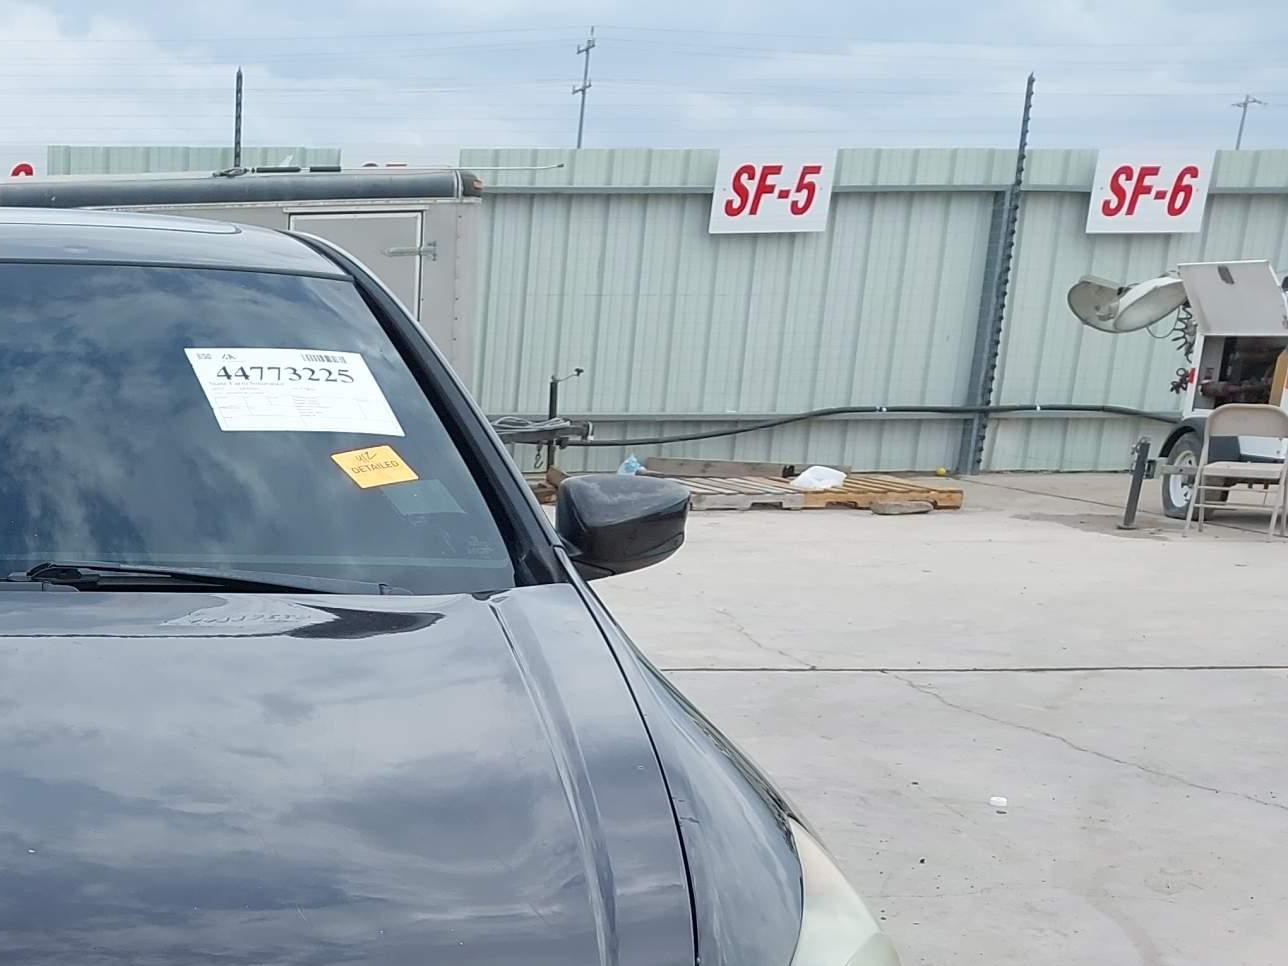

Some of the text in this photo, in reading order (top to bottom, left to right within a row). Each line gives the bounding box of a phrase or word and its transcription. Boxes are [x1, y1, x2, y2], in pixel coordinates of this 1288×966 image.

[724, 164, 823, 217] SF-5
[1101, 165, 1199, 217] SF-6
[216, 366, 355, 384] 44773225
[351, 460, 400, 474] DETAILED
